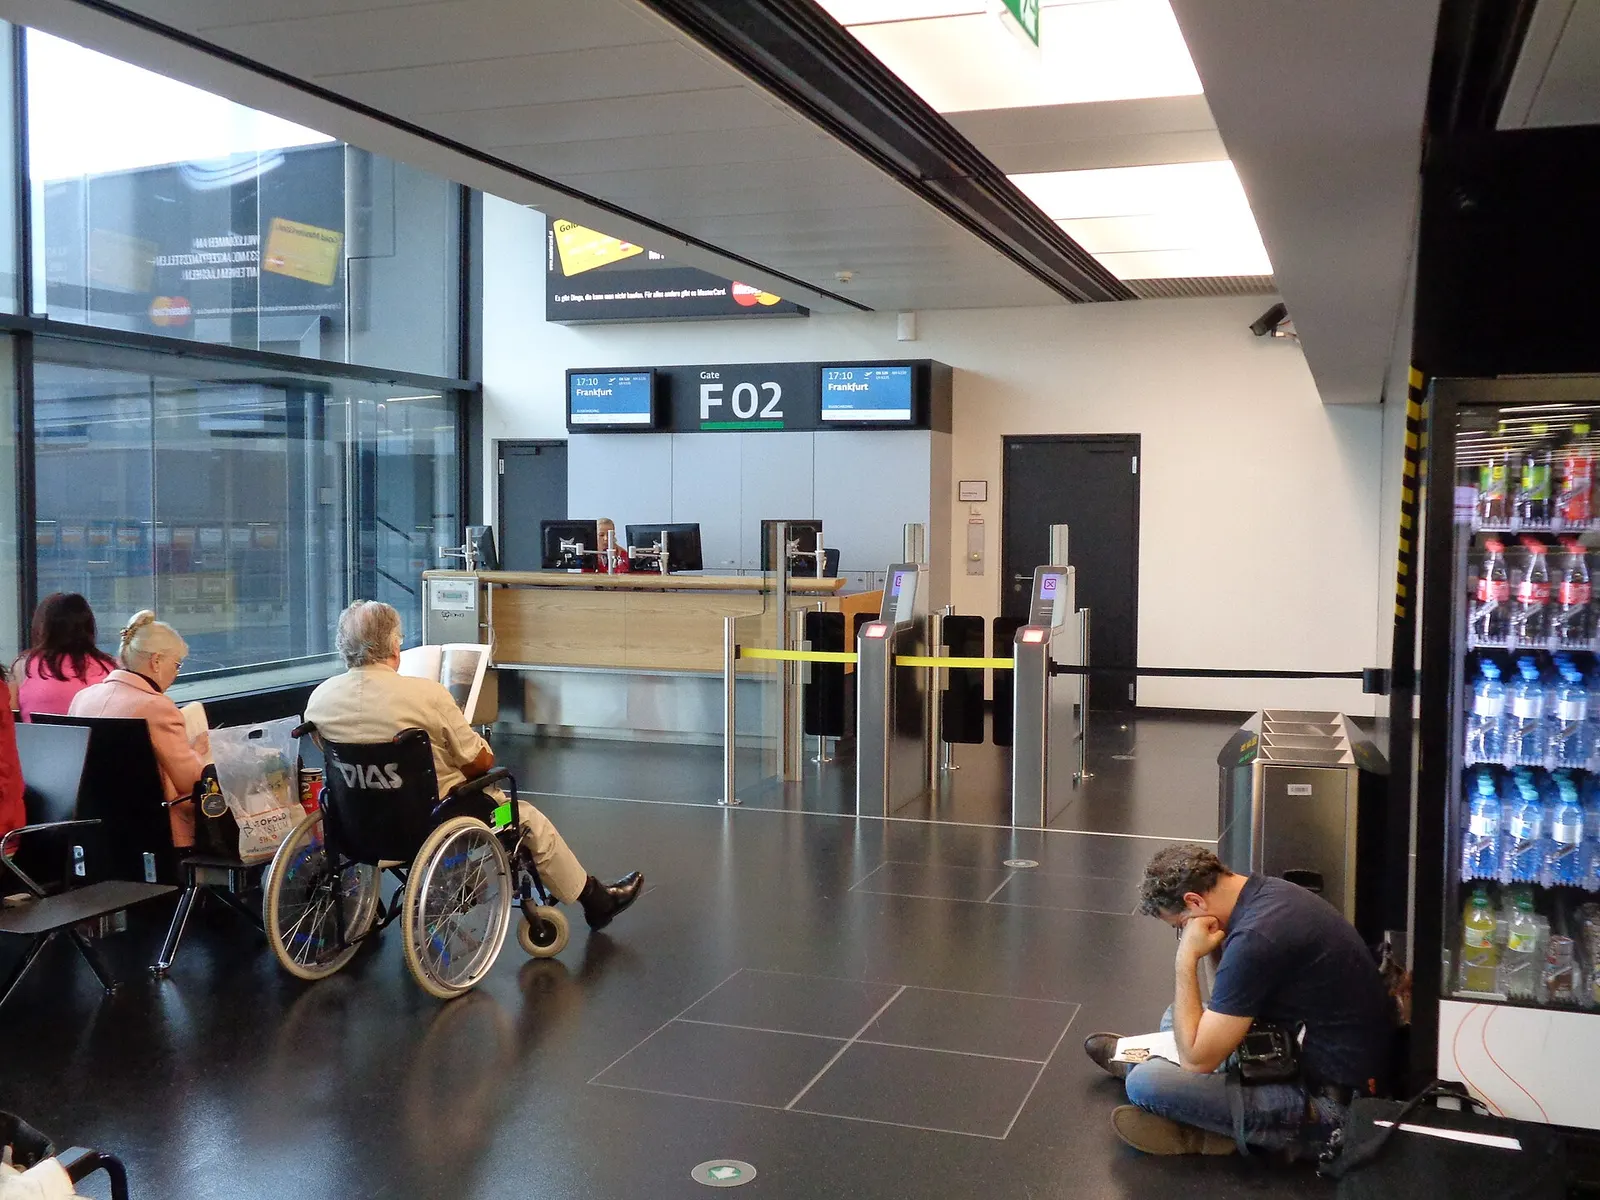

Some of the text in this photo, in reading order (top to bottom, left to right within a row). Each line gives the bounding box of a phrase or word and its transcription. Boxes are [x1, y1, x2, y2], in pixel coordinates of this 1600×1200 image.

[700, 371, 720, 379] Gate
[828, 371, 853, 380] 17:10
[576, 377, 599, 386] 17:10
[828, 382, 869, 393] Frankfurt
[576, 388, 613, 398] Frankfurt
[700, 381, 784, 420] F 02
